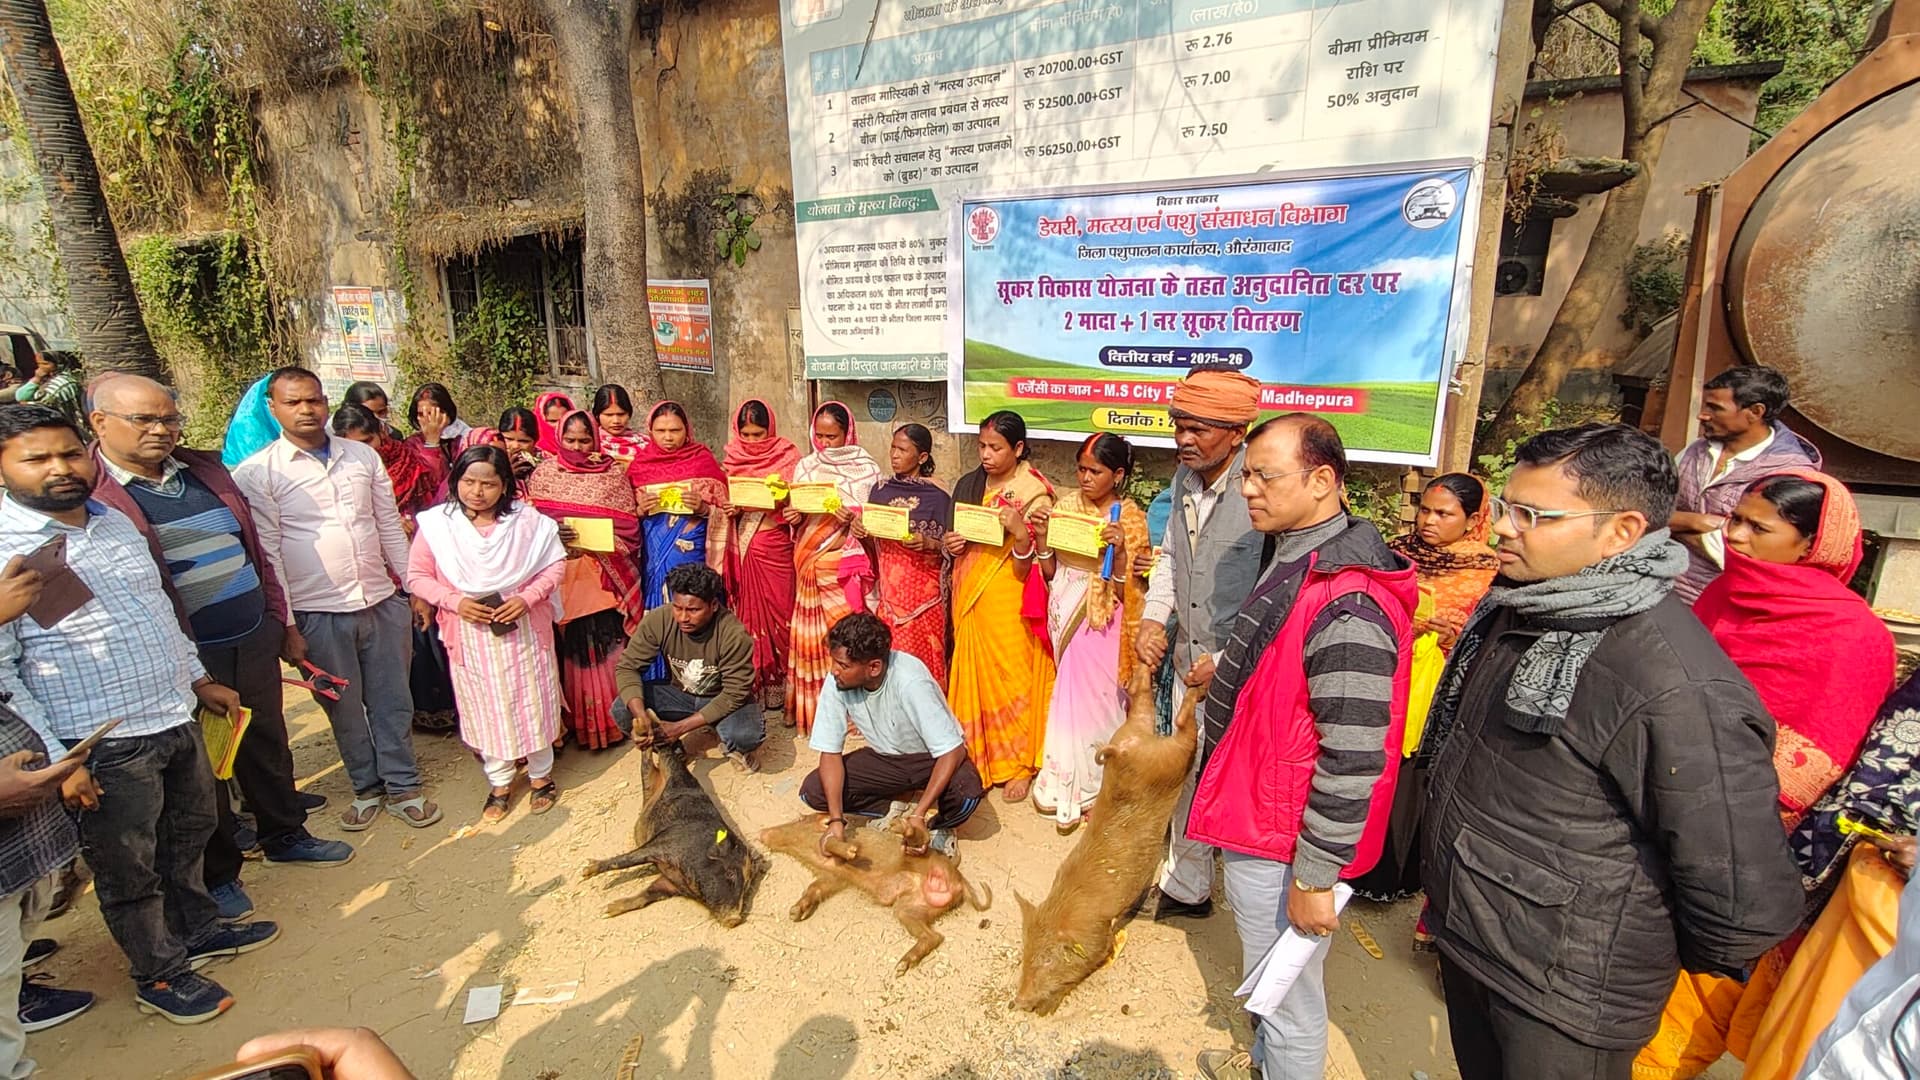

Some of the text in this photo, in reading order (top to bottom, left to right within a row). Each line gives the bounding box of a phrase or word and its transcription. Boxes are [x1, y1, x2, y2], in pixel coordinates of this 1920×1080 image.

[1203, 32, 1232, 48] 2.76
[1328, 30, 1429, 56] बीमा प्रीमियम
[1038, 51, 1123, 76] 20700.00+GST
[1346, 61, 1405, 80] राशि पर
[1202, 70, 1231, 86] 7.00
[921, 81, 930, 95] से
[827, 99, 832, 109] 1
[970, 97, 979, 111] से
[982, 96, 1009, 109] मत्स्य
[1038, 87, 1122, 110] 52500.00+GST
[1327, 86, 1419, 108] 50% अनुदान
[952, 122, 964, 132] का
[967, 116, 1000, 130] उत्पादन
[1199, 122, 1228, 137] 7.50
[828, 133, 835, 143] 2
[1038, 136, 1121, 157] 56250.00+GST
[928, 145, 942, 163] हेतु
[831, 165, 837, 176] 3
[883, 169, 894, 183] को
[931, 166, 942, 177] का
[945, 162, 979, 176] उत्पादन
[808, 202, 840, 217] योजना
[844, 199, 856, 213] के
[859, 199, 885, 216] मुख्य
[1156, 194, 1219, 206] बिहार सरकार
[1039, 202, 1348, 237] डेयरी, मत्स्य एवं पशु संसाधन विभाग
[878, 241, 897, 250] फसल
[1078, 239, 1292, 262] जिला पशुपालन कार्यालय, औरंगाबाद
[931, 286, 946, 295] कम्प
[996, 268, 1402, 305] सूकर विकास योजना के तहत अनुदानित दर पर
[1064, 306, 1302, 338] 2 मादा + 1 नर सूकर वितरण
[1108, 350, 1149, 364] वित्तीय
[1151, 350, 1174, 364] वर्ष
[1051, 383, 1066, 395] का
[1068, 385, 1092, 397] नाम
[1104, 384, 1129, 398] M.S
[1133, 385, 1161, 401] City
[1261, 389, 1354, 409] Madhepura
[1108, 410, 1154, 427] दिनांक
